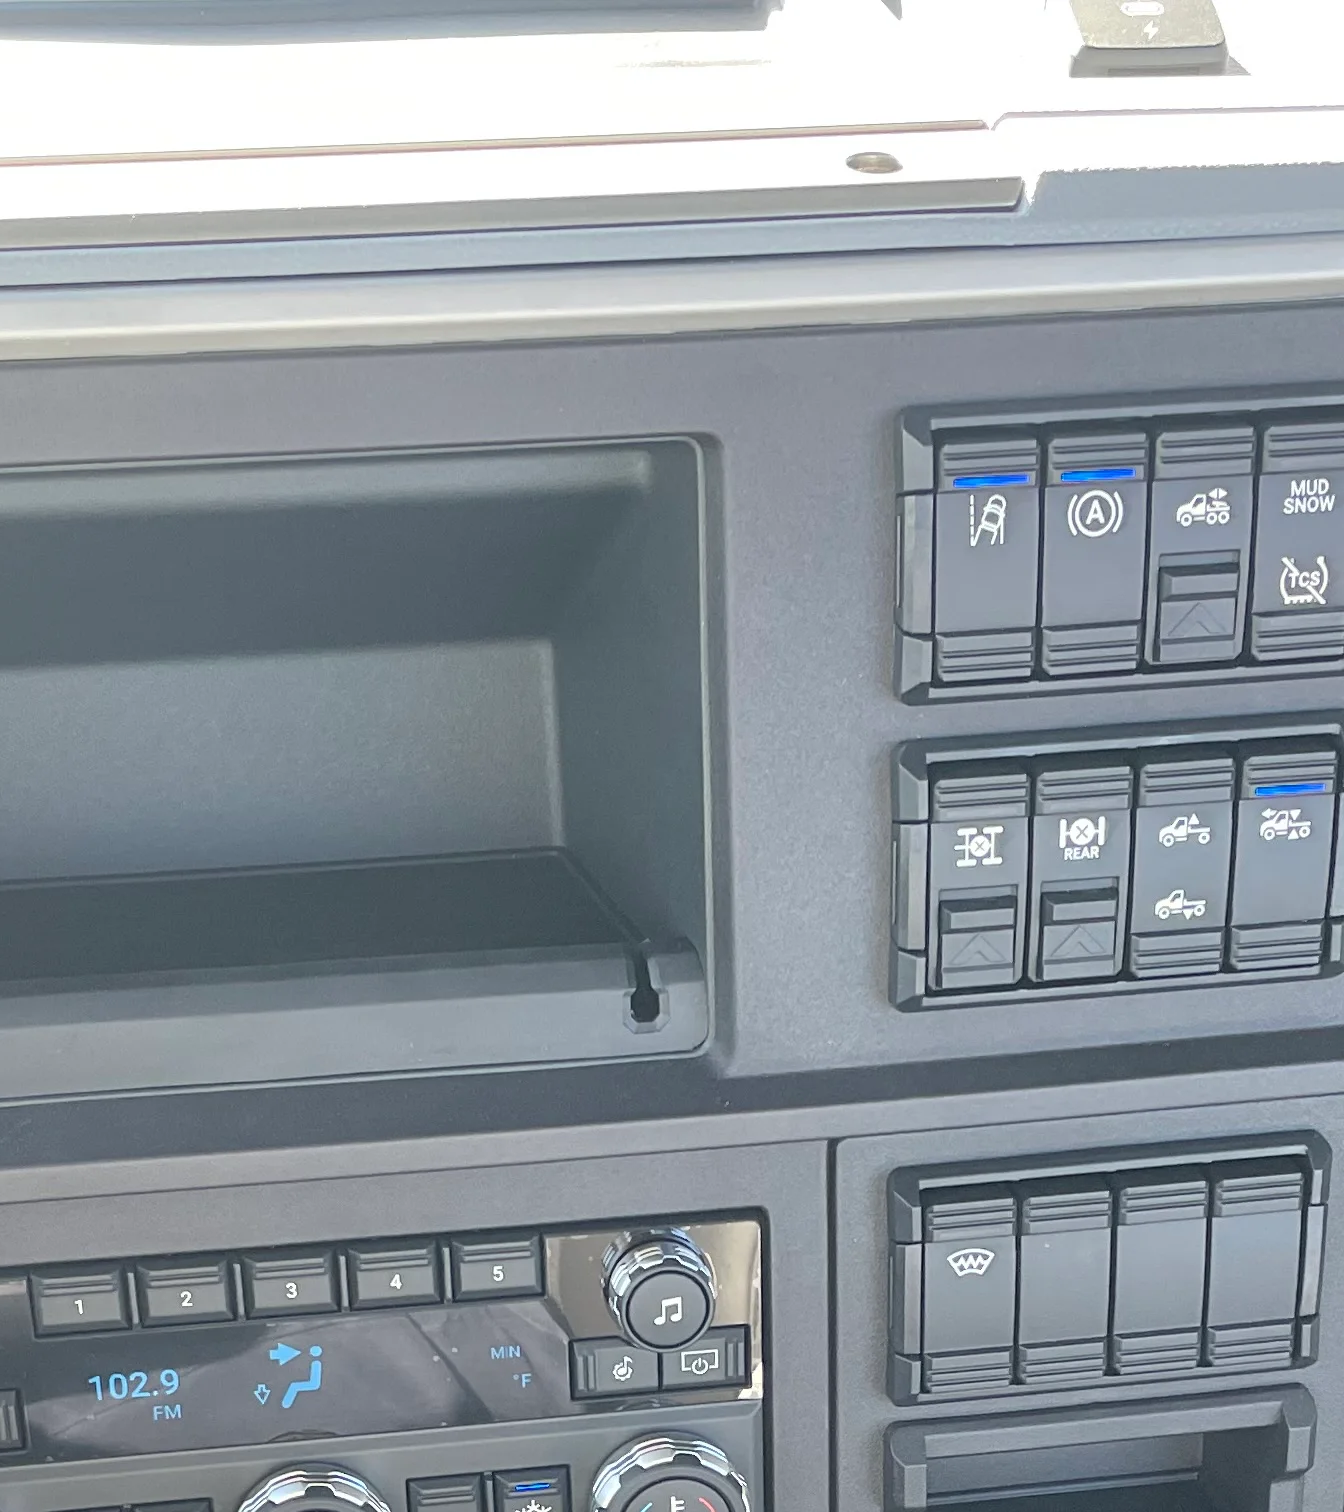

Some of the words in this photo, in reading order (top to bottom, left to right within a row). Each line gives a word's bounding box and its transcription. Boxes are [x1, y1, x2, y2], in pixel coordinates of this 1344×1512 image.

[1290, 478, 1330, 498] MUD
[1282, 494, 1336, 515] SNOW
[1288, 570, 1322, 589] TCS
[1063, 845, 1100, 861] REAR
[389, 1274, 403, 1290] 4
[492, 1266, 505, 1282] 5
[285, 1282, 299, 1299] 3
[74, 1299, 84, 1315] 1
[180, 1291, 193, 1307] 2
[490, 1345, 521, 1360] MIN
[87, 1369, 180, 1401] 102.9
[152, 1404, 183, 1421] FM
